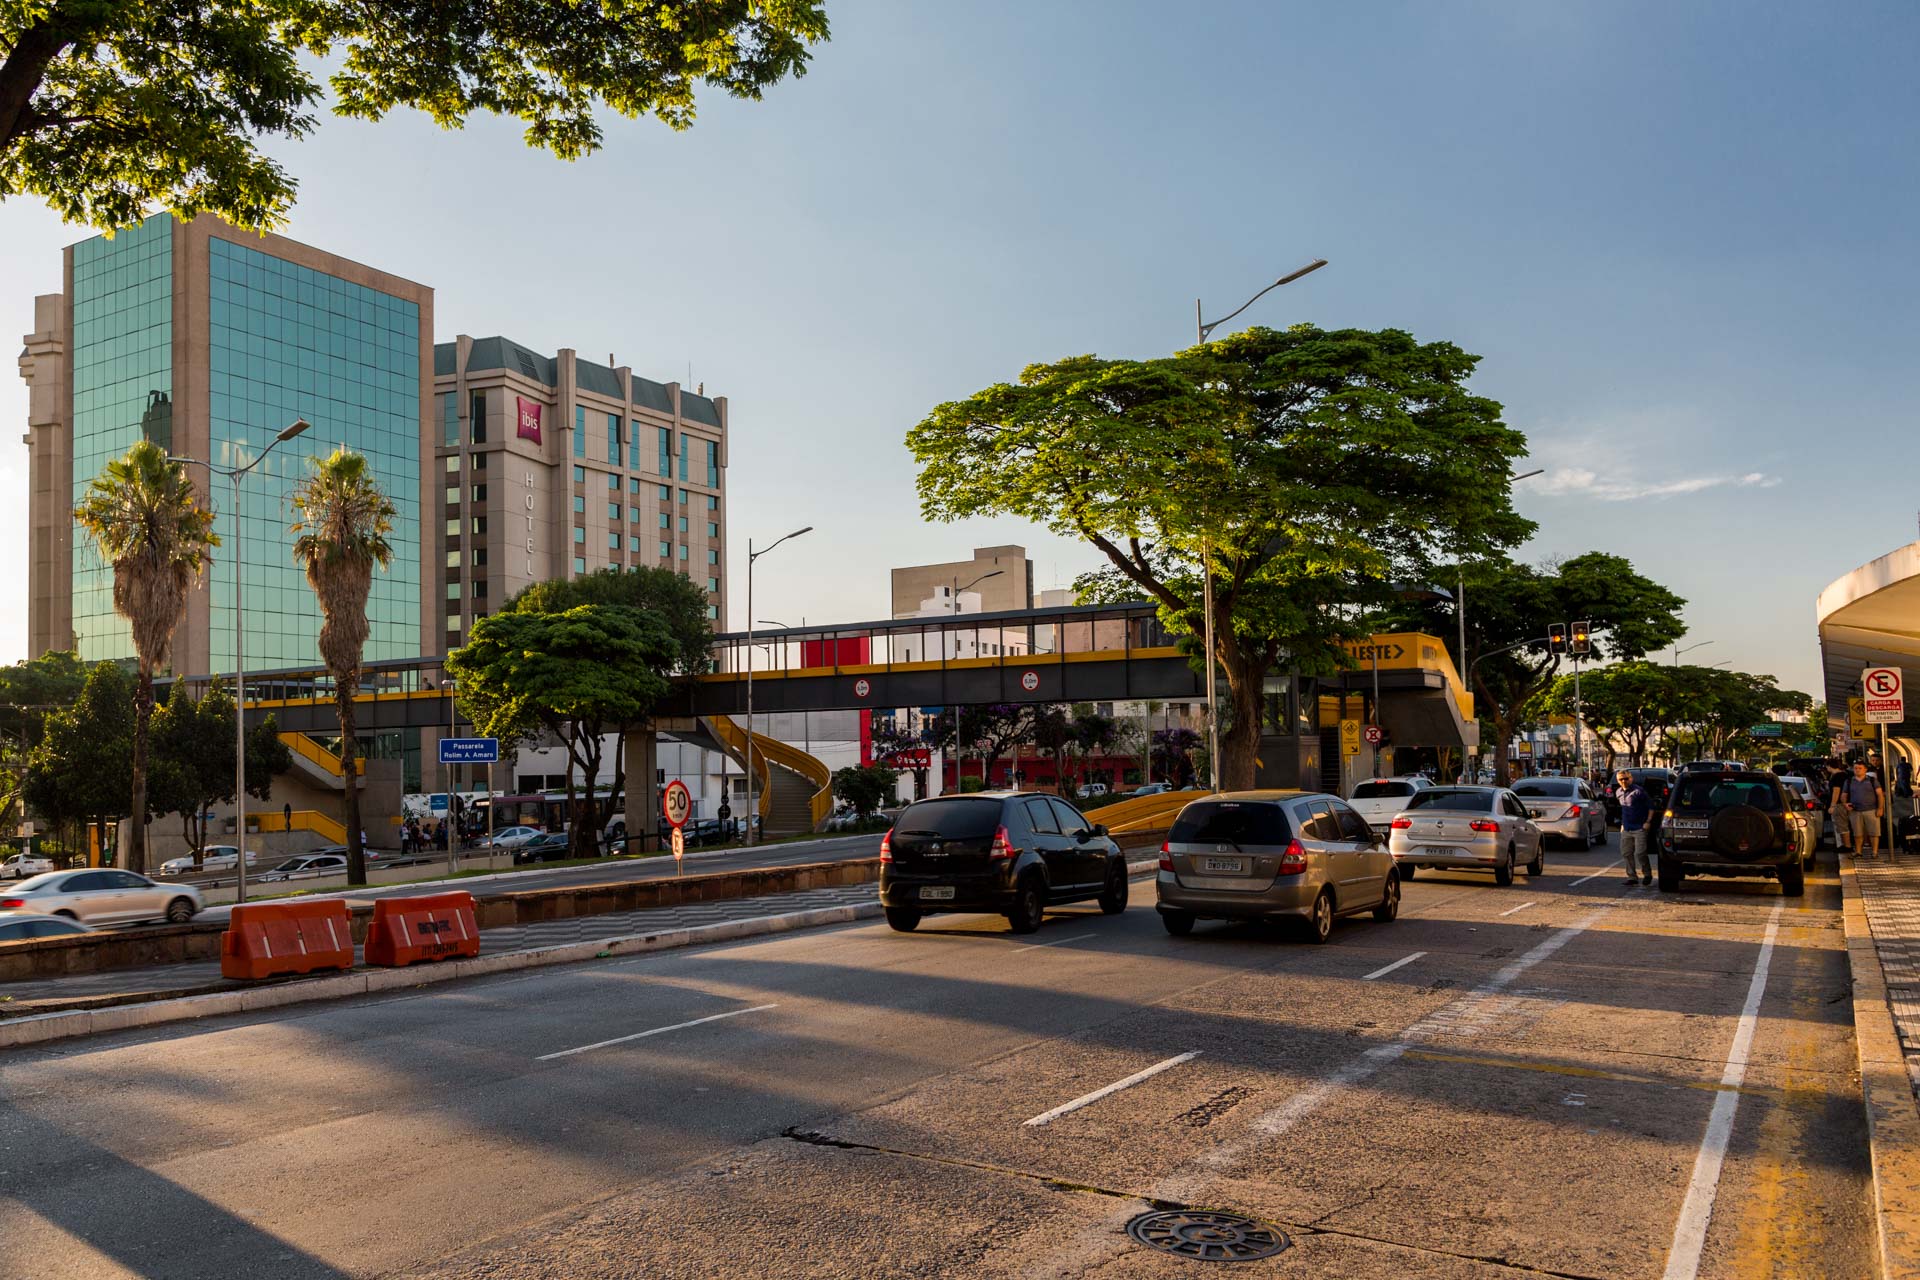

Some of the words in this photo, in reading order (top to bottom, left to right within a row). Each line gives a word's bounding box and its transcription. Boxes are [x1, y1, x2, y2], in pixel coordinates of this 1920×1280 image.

[522, 410, 538, 430] ibis
[525, 472, 534, 575] HOTEL
[669, 790, 686, 811] 50
